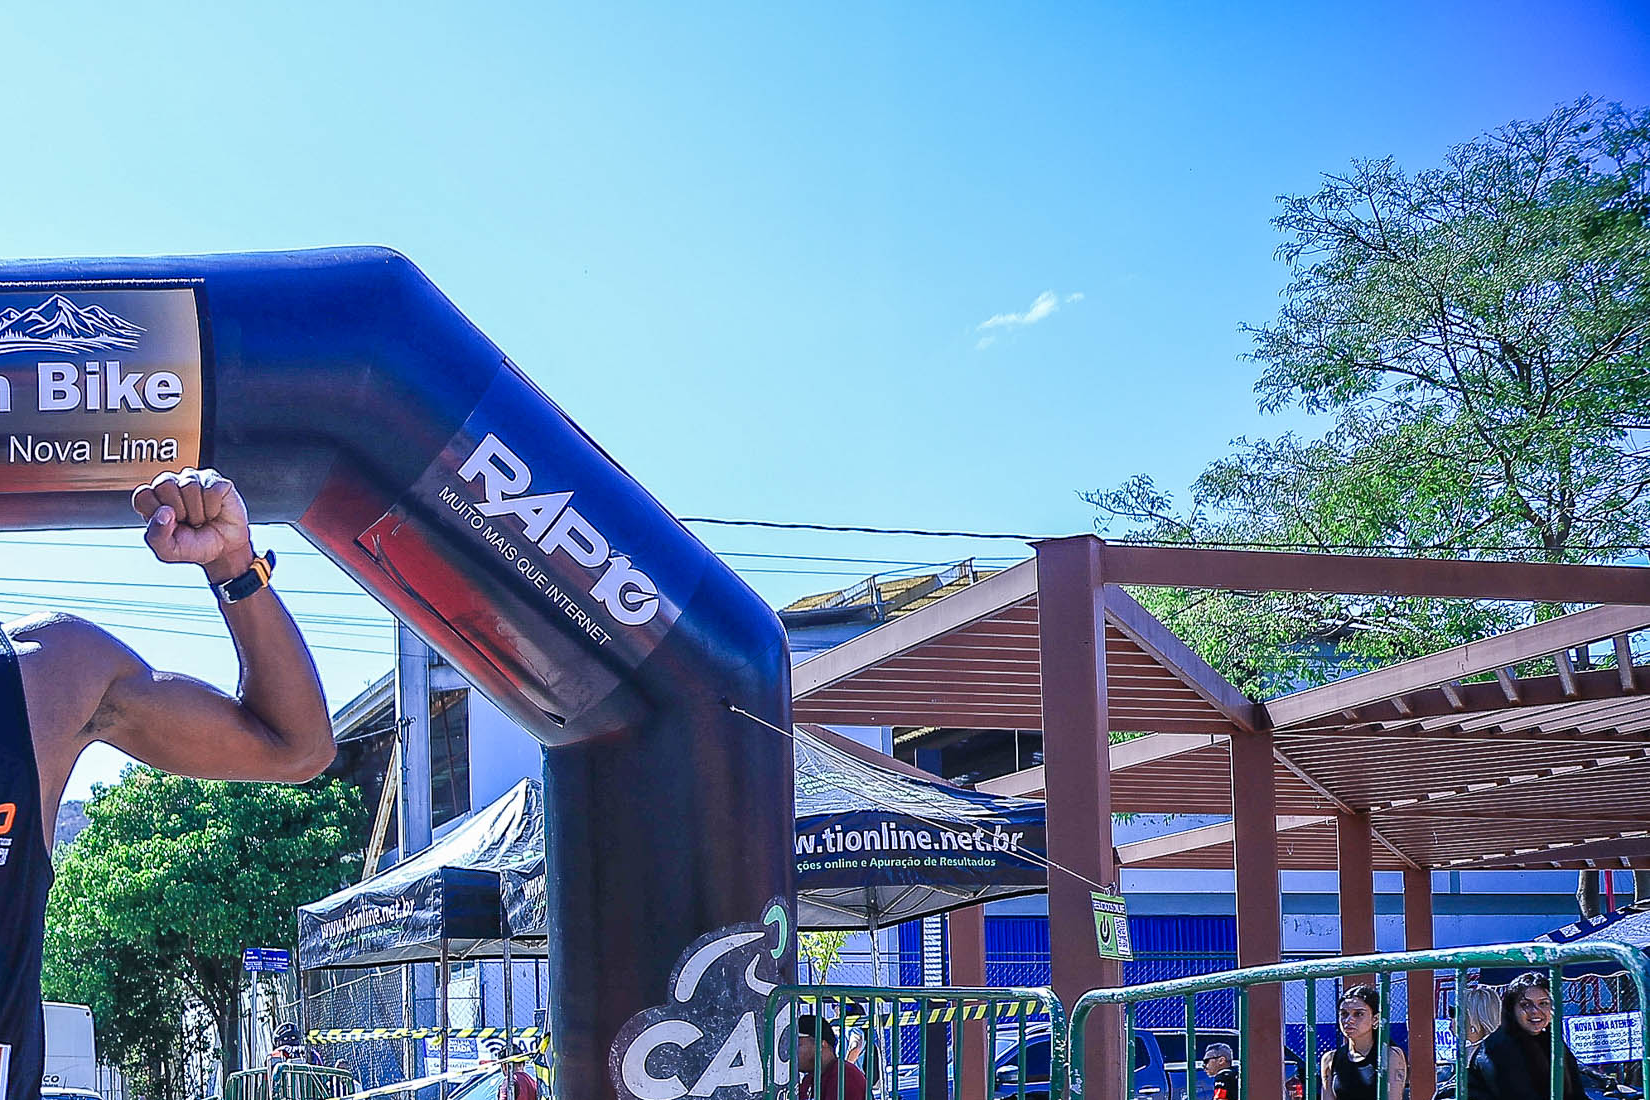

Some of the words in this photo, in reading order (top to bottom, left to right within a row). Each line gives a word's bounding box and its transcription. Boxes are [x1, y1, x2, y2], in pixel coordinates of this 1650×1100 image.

[37, 360, 182, 412] Bike
[9, 434, 91, 464] Nova
[102, 432, 179, 462] Lima
[437, 485, 485, 531] MUITO
[481, 525, 519, 562] MAIS
[515, 556, 549, 590] QUE
[543, 583, 613, 646] INTERNET
[796, 822, 1024, 855] w.tionline.net.br
[797, 858, 822, 873] ções
[824, 858, 858, 870] online
[861, 860, 867, 868] e
[870, 857, 921, 869] Apuração
[924, 857, 937, 867] de
[940, 857, 996, 868] Resultados
[321, 896, 415, 939] www.tionline.net.br
[42, 1075, 60, 1083] CO
